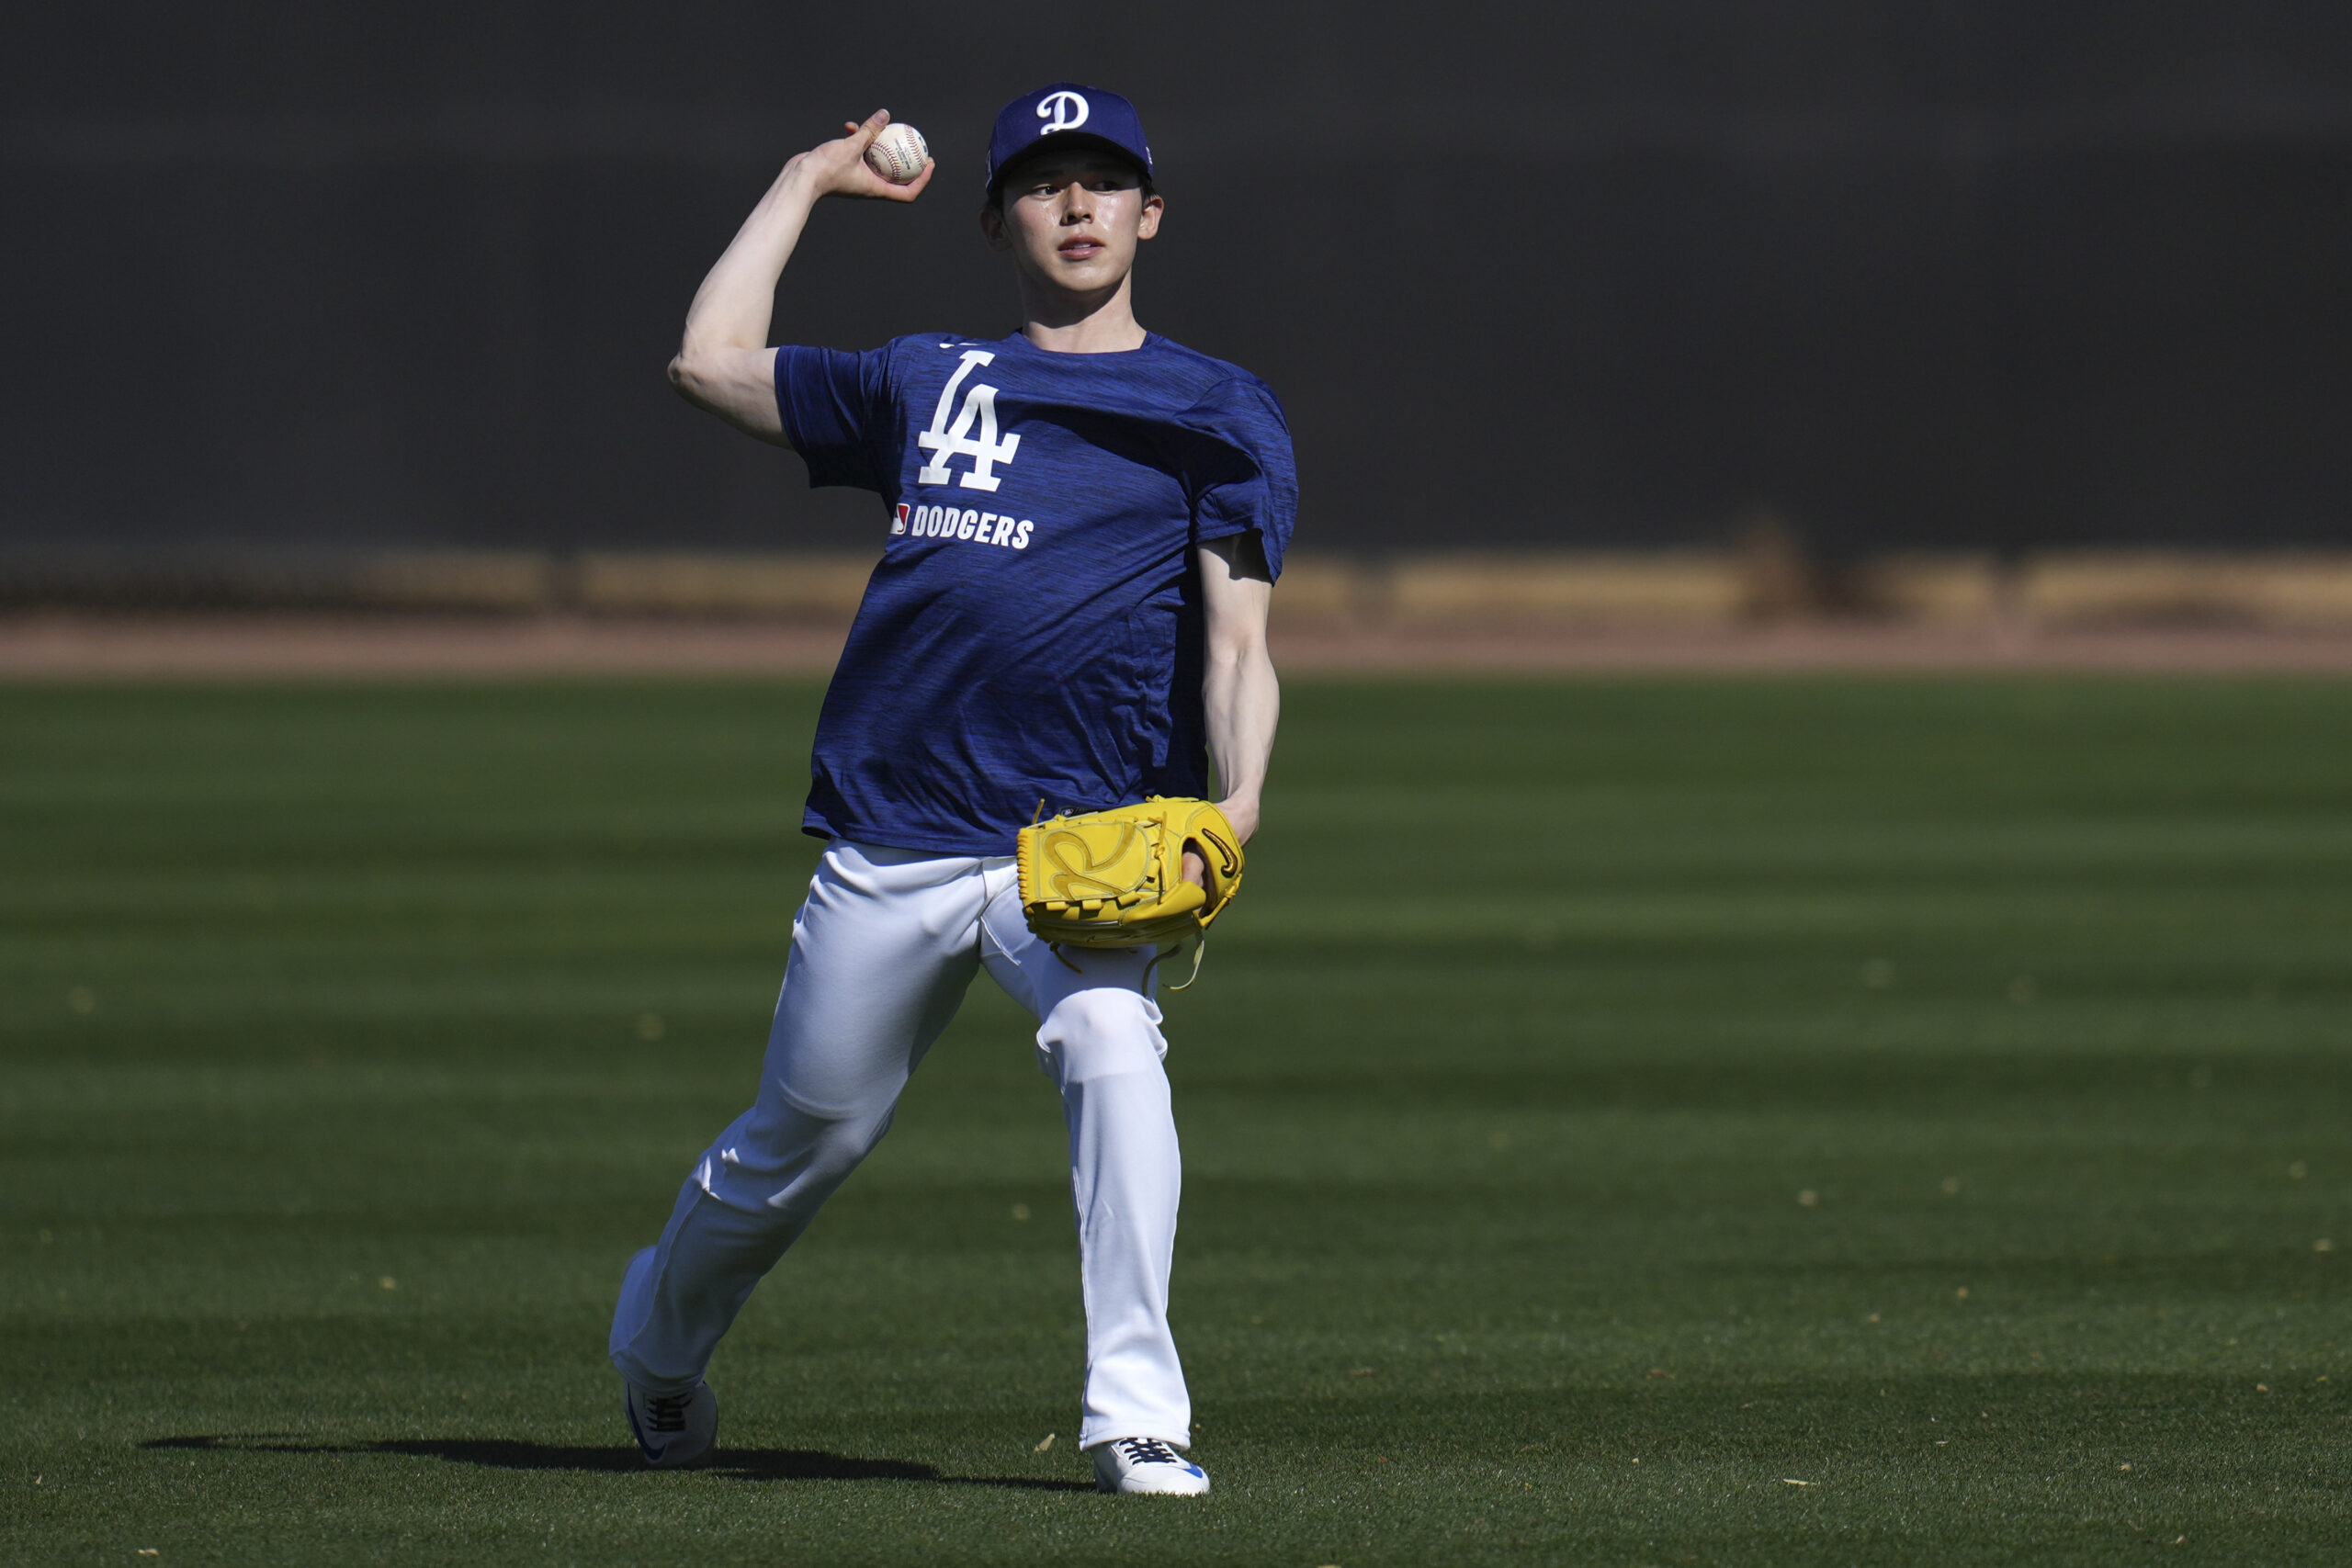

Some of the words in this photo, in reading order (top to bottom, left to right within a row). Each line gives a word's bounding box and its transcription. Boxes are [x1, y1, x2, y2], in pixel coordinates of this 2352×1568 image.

[1036, 91, 1090, 135] D
[918, 350, 1021, 491] LA
[911, 505, 1034, 549] DODGERS
